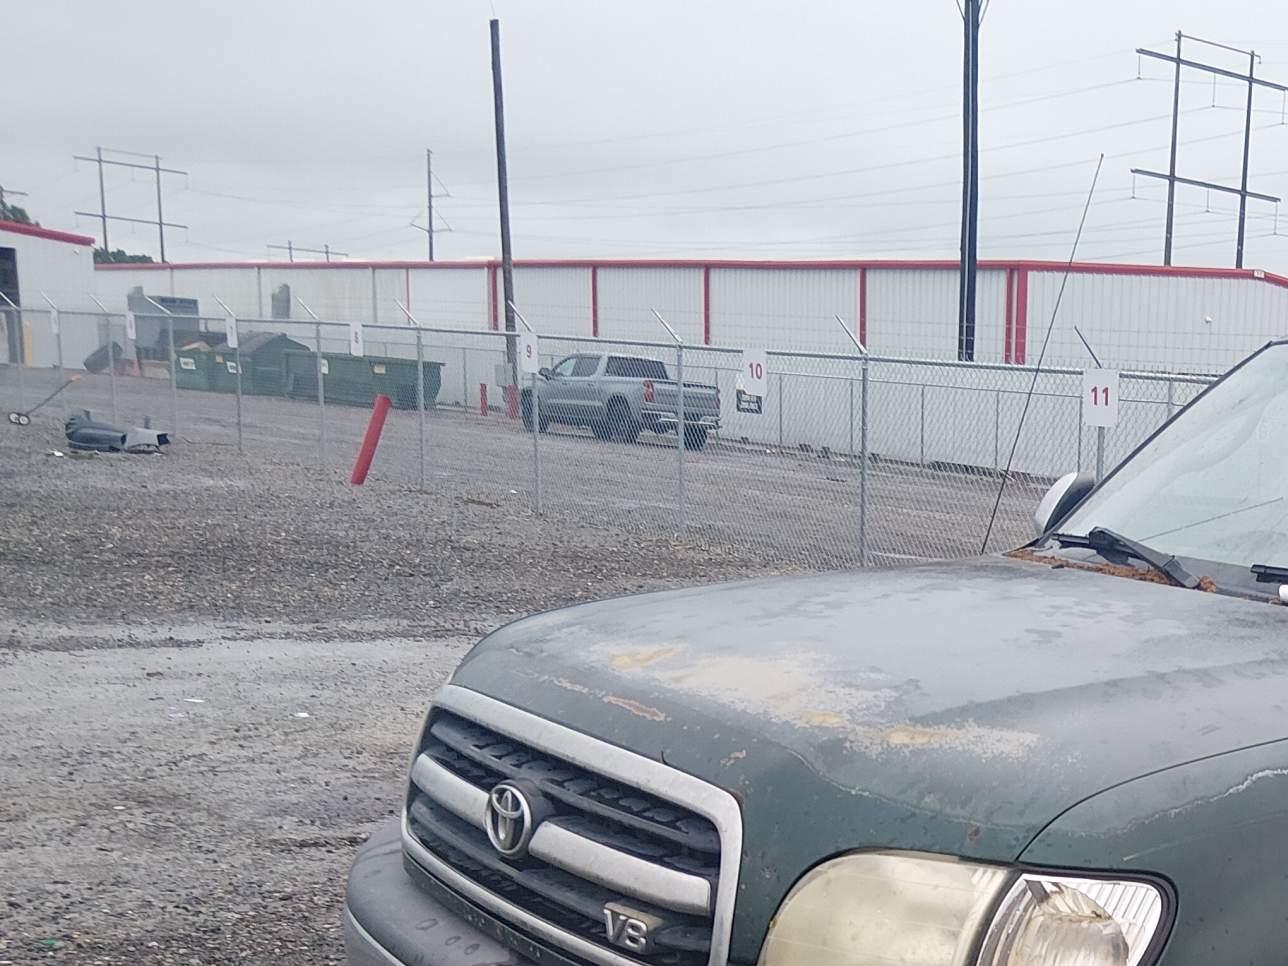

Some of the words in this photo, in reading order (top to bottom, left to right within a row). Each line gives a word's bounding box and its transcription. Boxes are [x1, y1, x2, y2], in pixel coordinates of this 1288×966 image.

[526, 343, 532, 359] 9
[749, 362, 763, 380] 10
[1090, 385, 1110, 407] 11
[602, 906, 648, 949] V8
